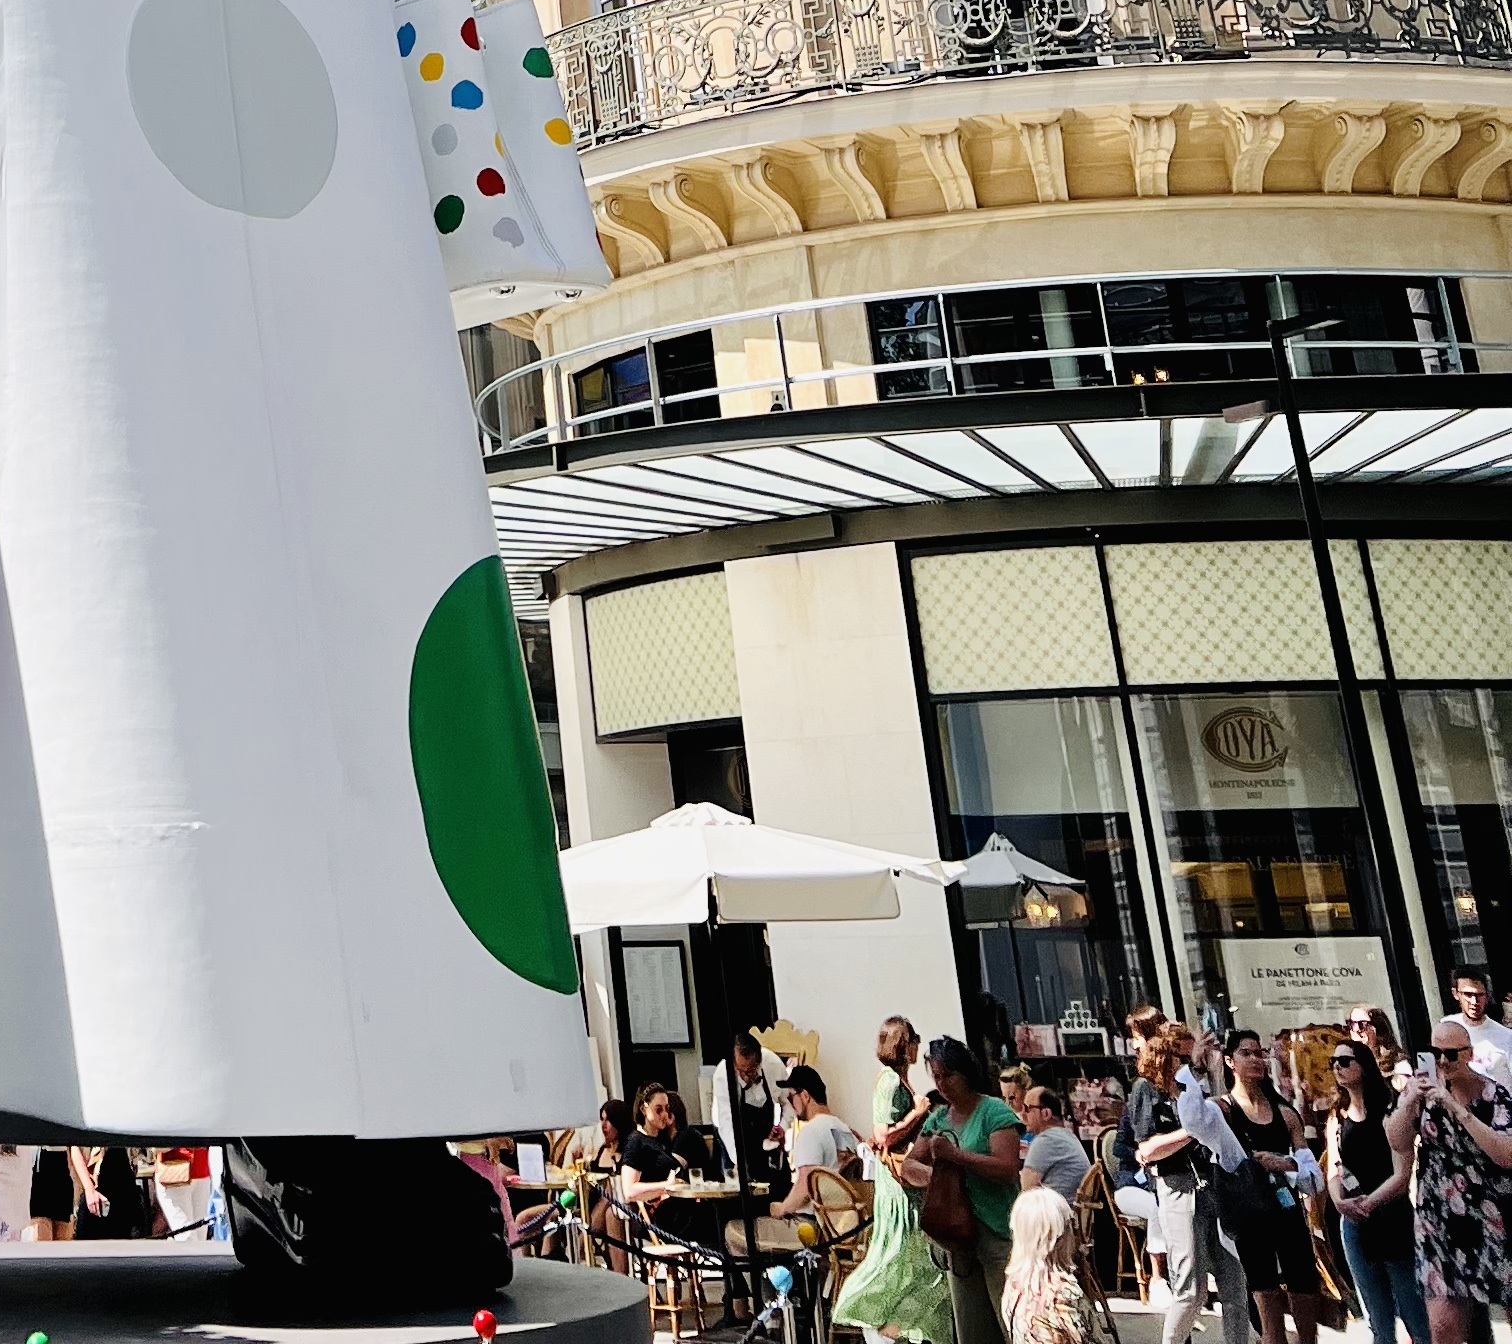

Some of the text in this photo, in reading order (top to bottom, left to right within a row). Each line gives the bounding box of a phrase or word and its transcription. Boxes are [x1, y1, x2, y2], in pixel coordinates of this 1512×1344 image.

[1250, 966, 1363, 979] LE PANETTONE COVA
